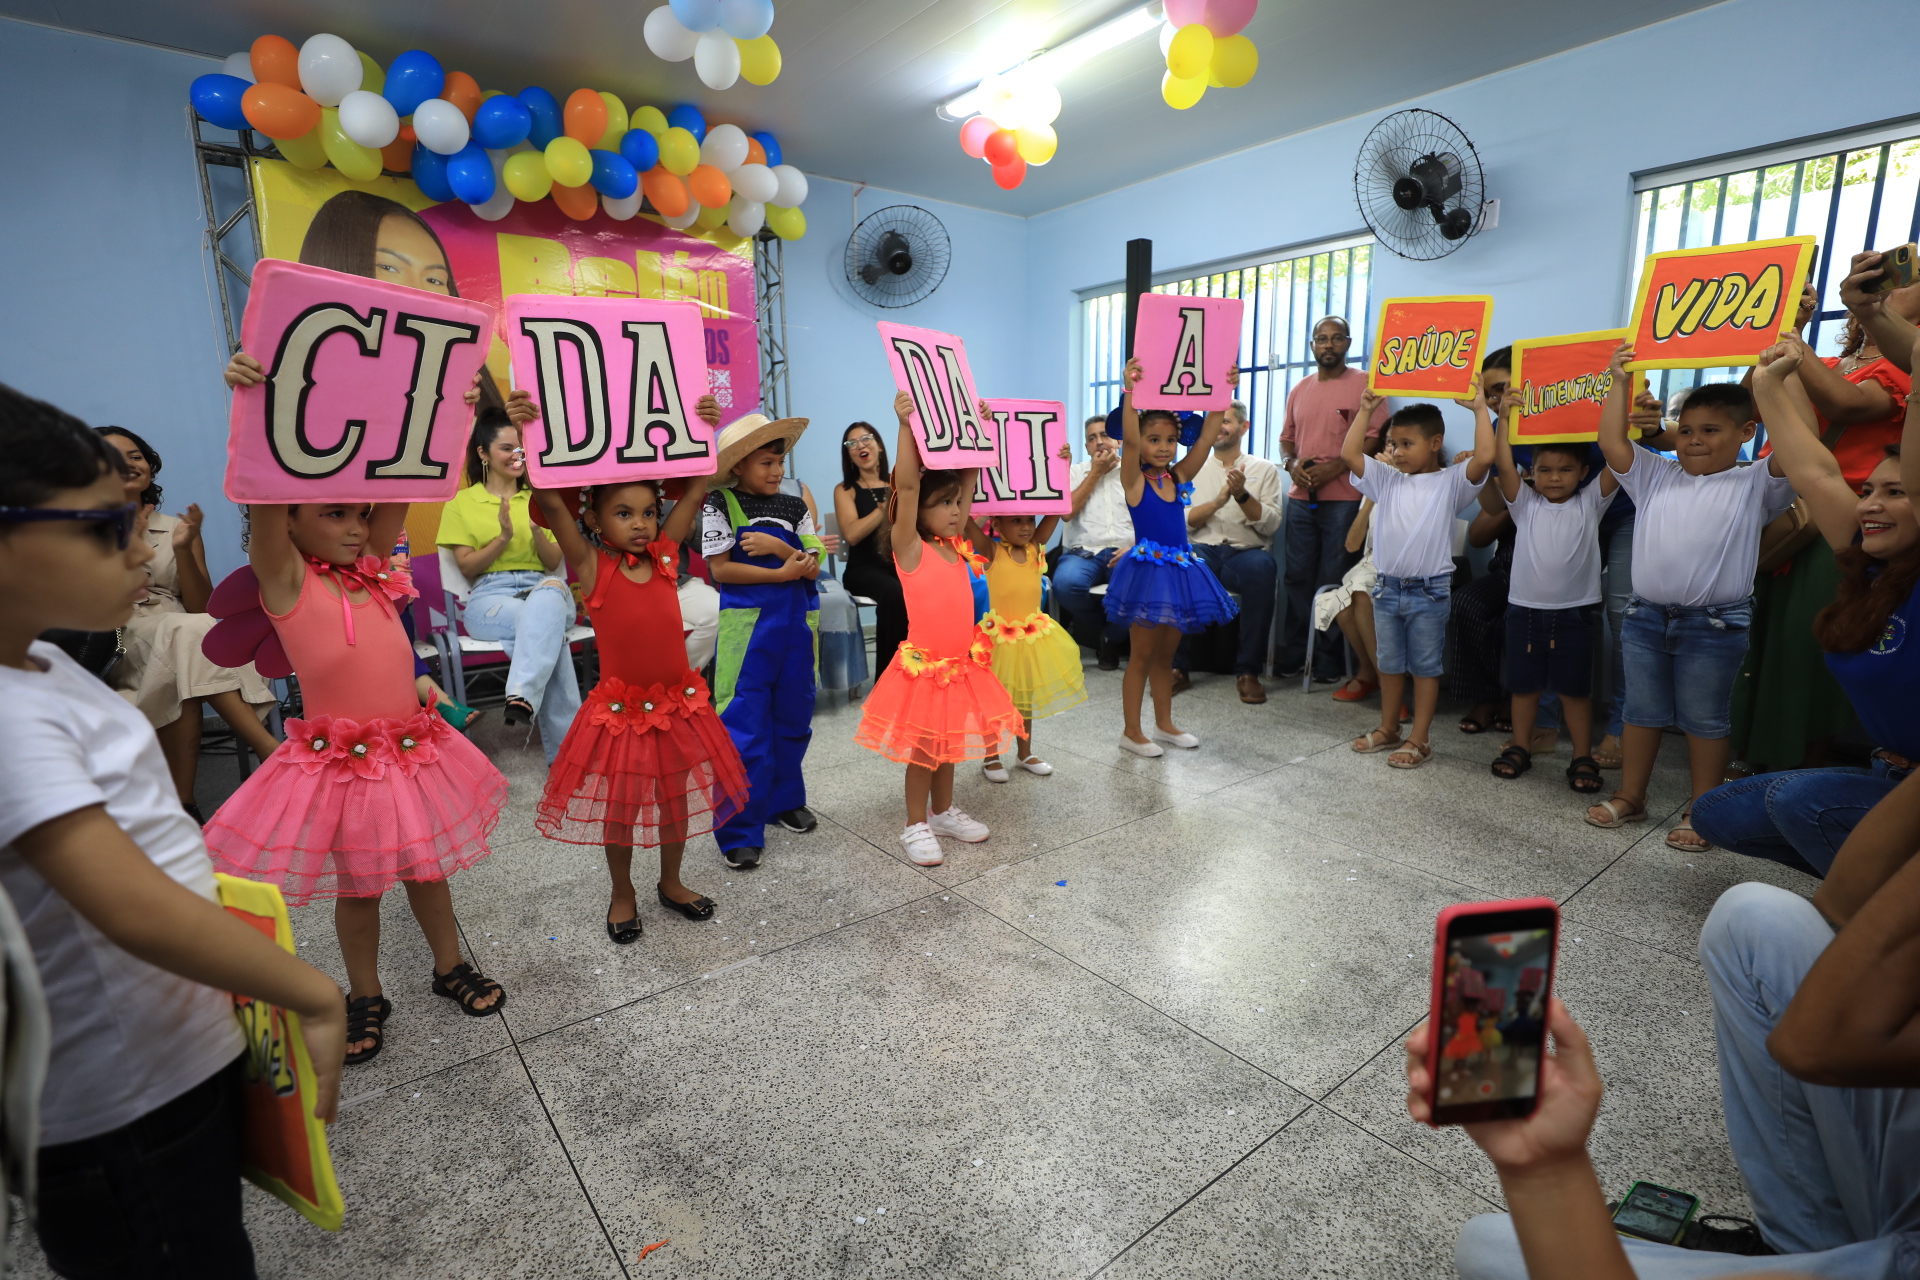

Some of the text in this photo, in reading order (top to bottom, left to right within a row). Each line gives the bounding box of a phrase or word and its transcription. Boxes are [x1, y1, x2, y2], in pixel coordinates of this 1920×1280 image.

[1652, 264, 1784, 342] VIDA
[265, 302, 480, 480] CI
[519, 317, 709, 468] DA
[891, 336, 994, 452] DA
[1160, 307, 1213, 396] A
[1378, 325, 1476, 377] SAÚDE
[1519, 366, 1613, 417] ALIMENTAÇÃ
